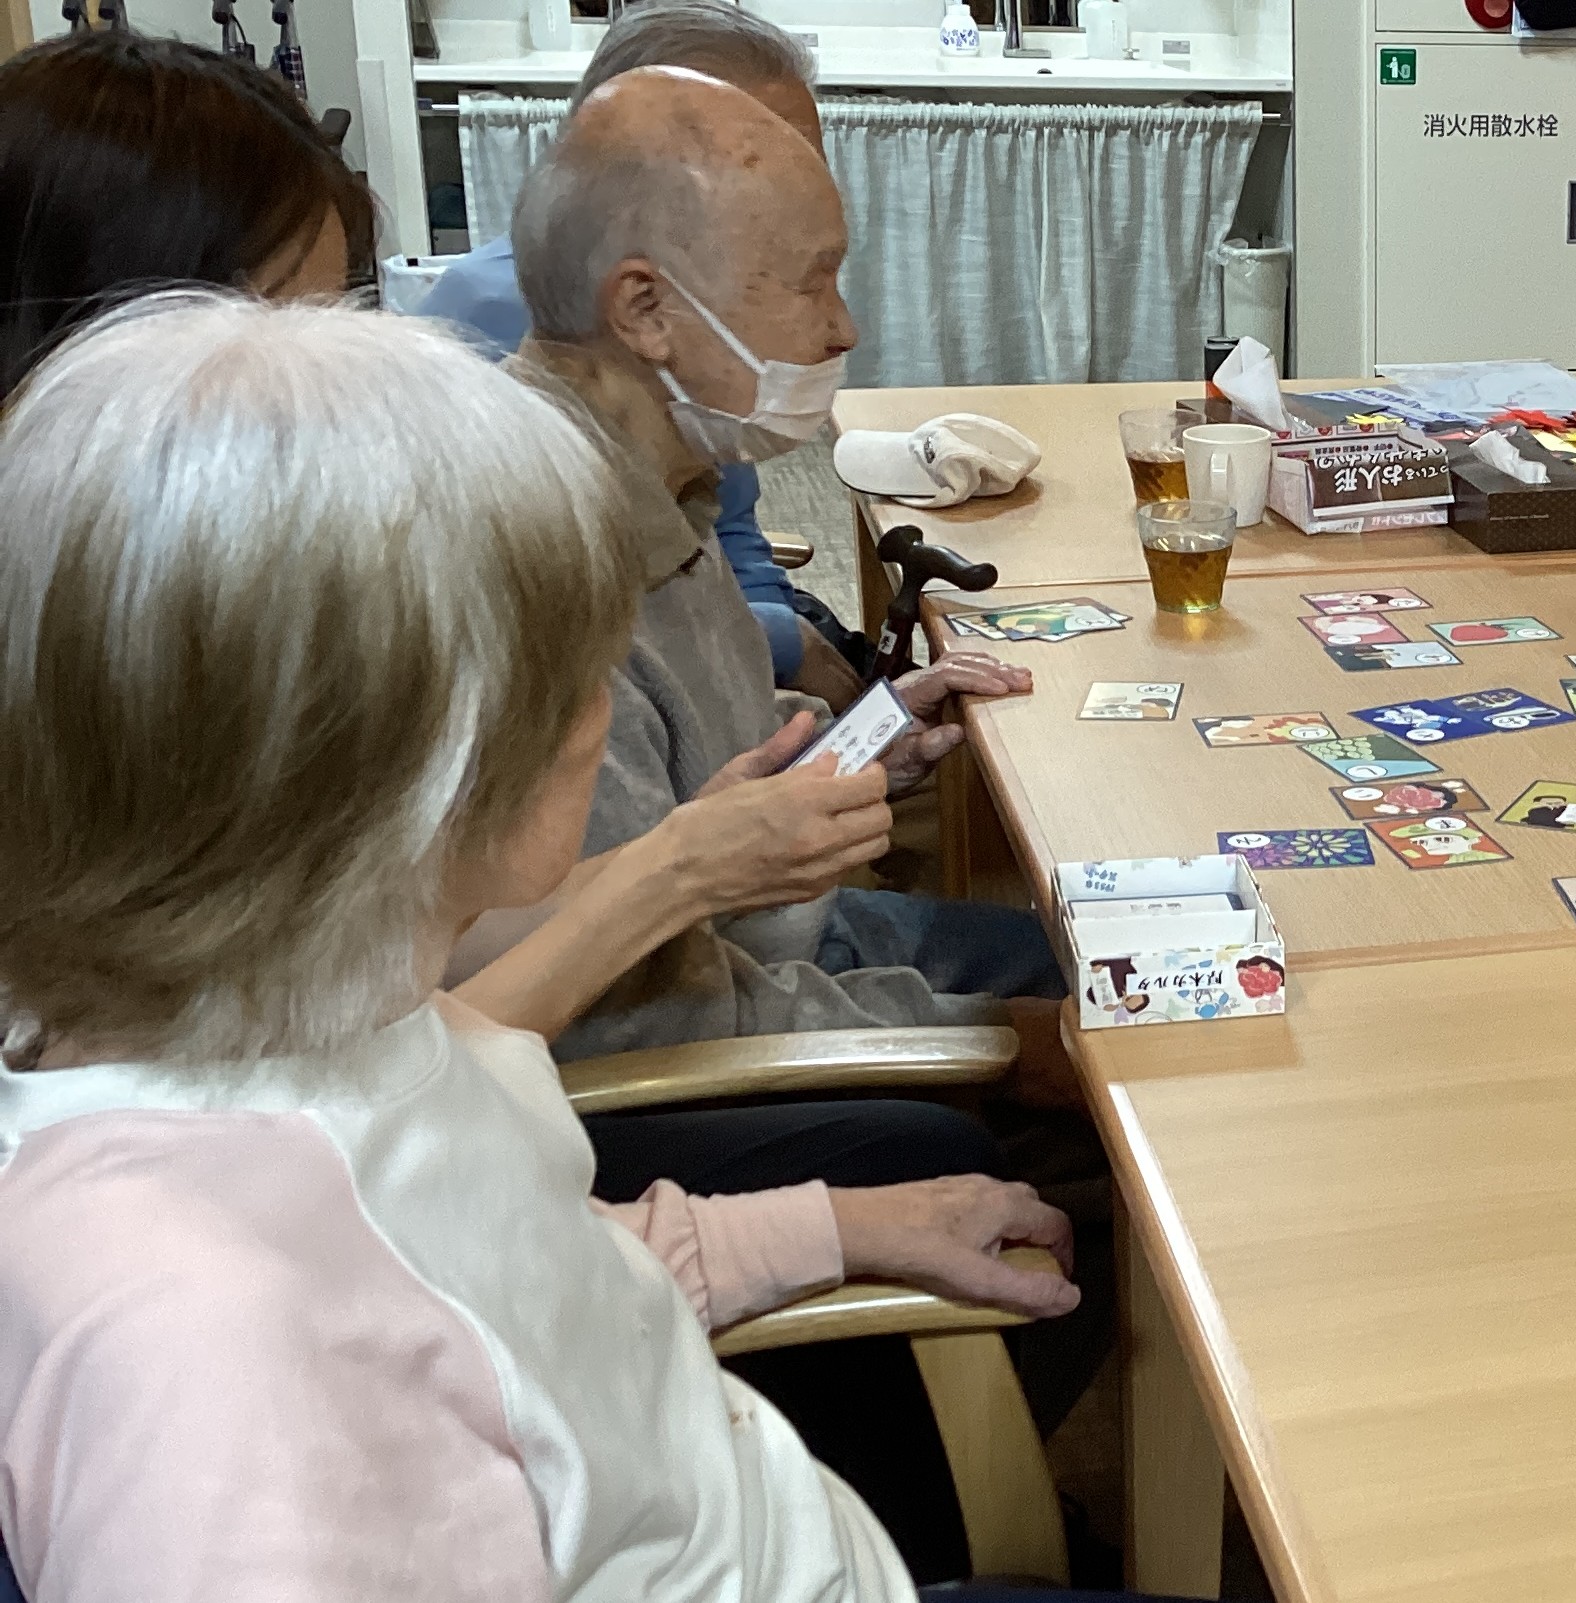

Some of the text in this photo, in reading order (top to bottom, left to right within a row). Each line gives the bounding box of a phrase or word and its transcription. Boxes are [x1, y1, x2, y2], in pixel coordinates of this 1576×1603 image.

[1423, 113, 1559, 138] 消火用散水栓
[1138, 969, 1224, 992] 厚木カルタ
